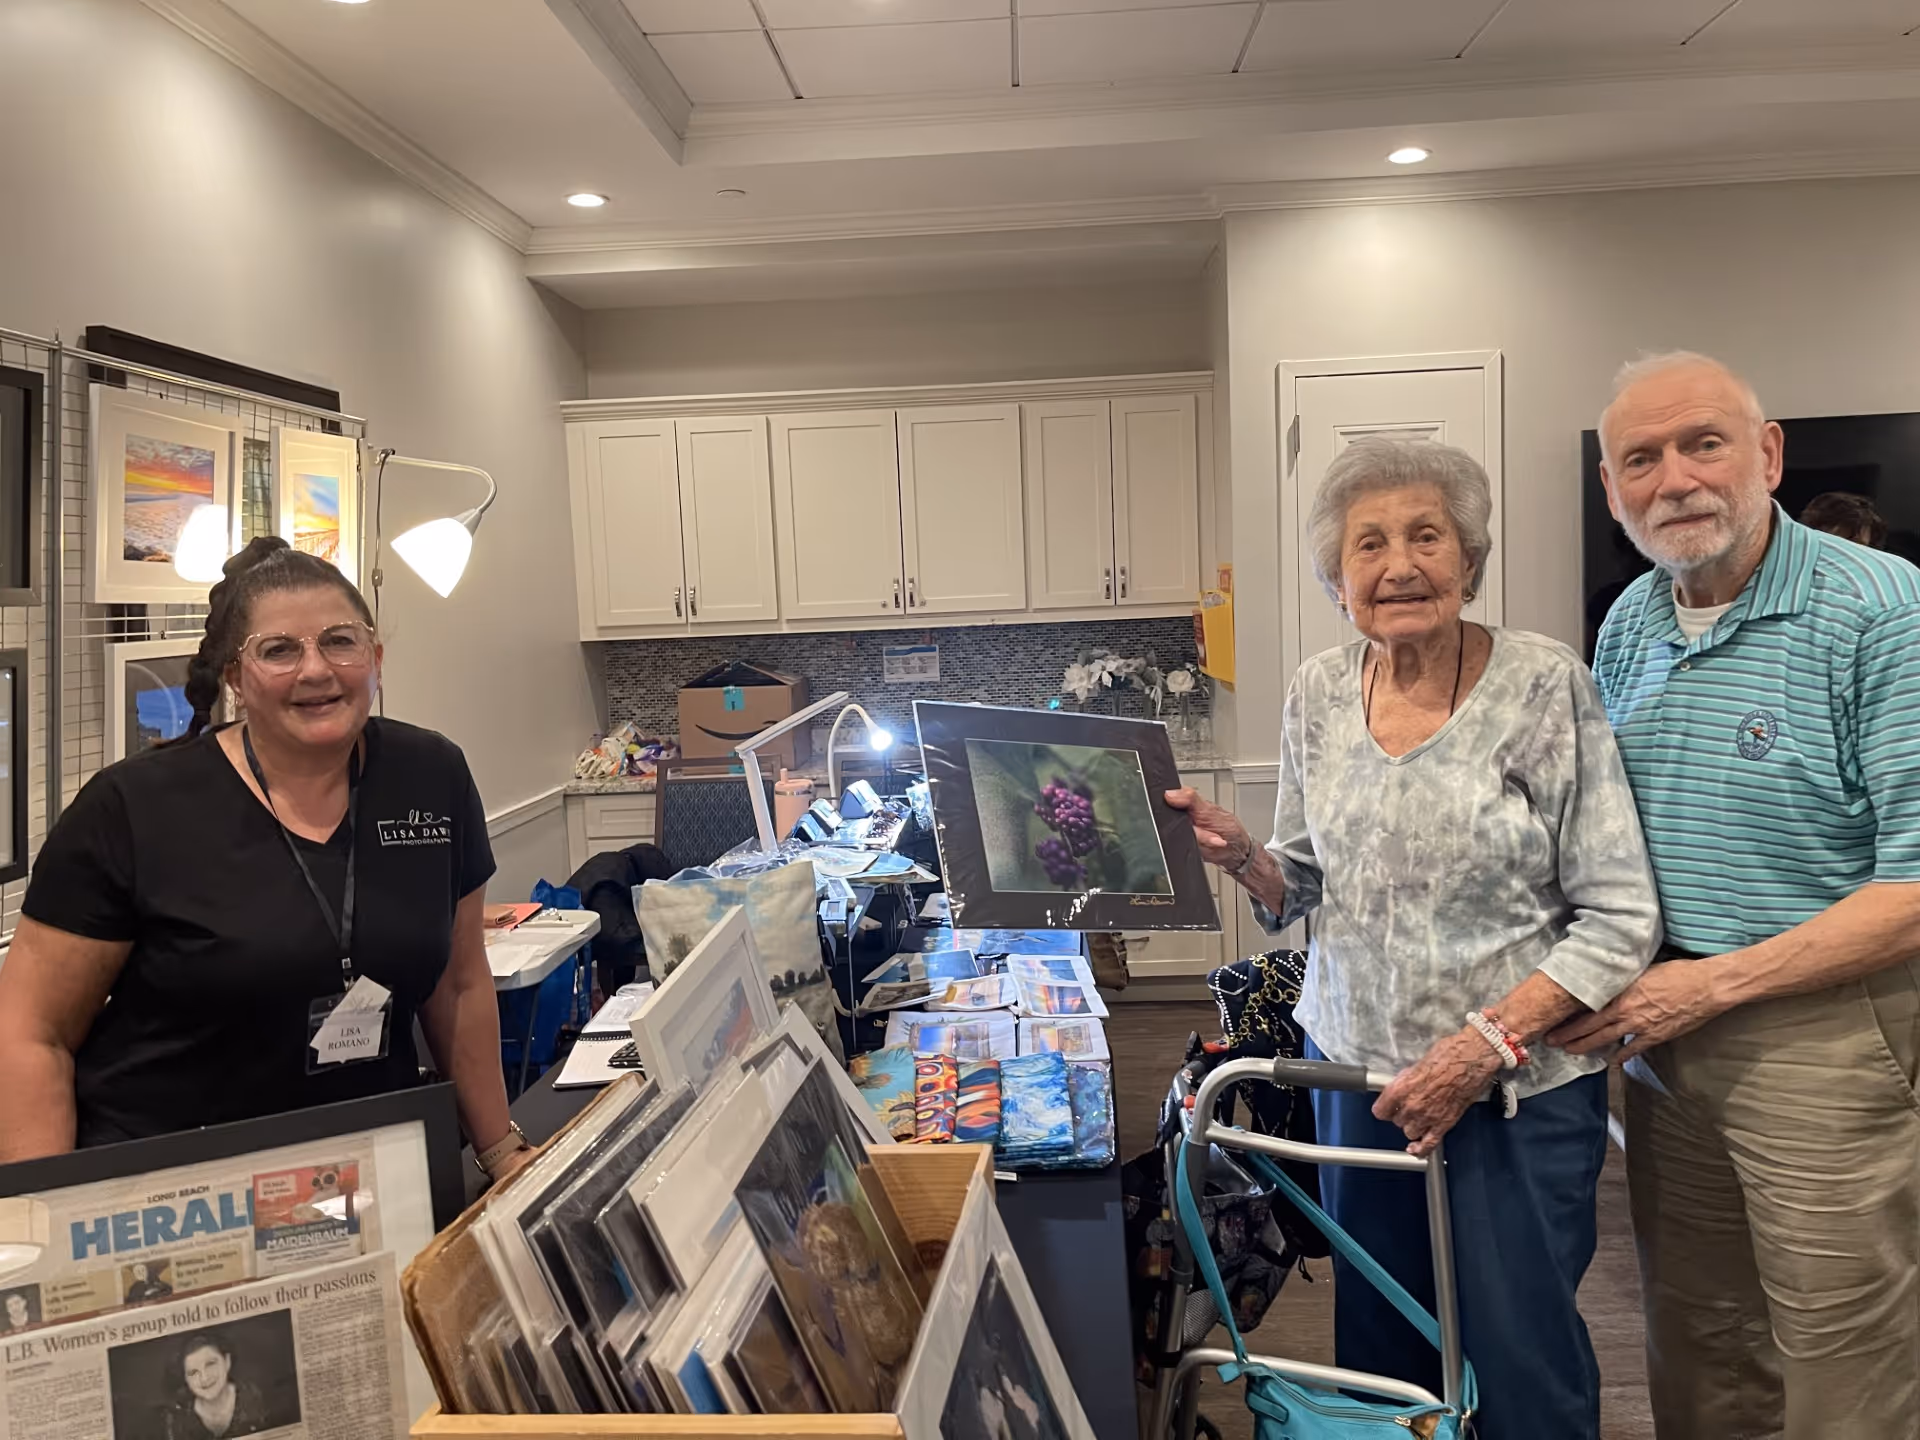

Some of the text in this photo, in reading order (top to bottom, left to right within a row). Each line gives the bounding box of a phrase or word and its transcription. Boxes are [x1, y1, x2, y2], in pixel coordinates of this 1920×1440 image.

[383, 829, 416, 841] LISA
[340, 1025, 362, 1038] LISA
[327, 1037, 370, 1051] ROMANO
[147, 1184, 210, 1204] LONG BEACH
[70, 1188, 254, 1261] HERAL
[5, 1270, 377, 1364] L.B. Women's group told to follow their passions
